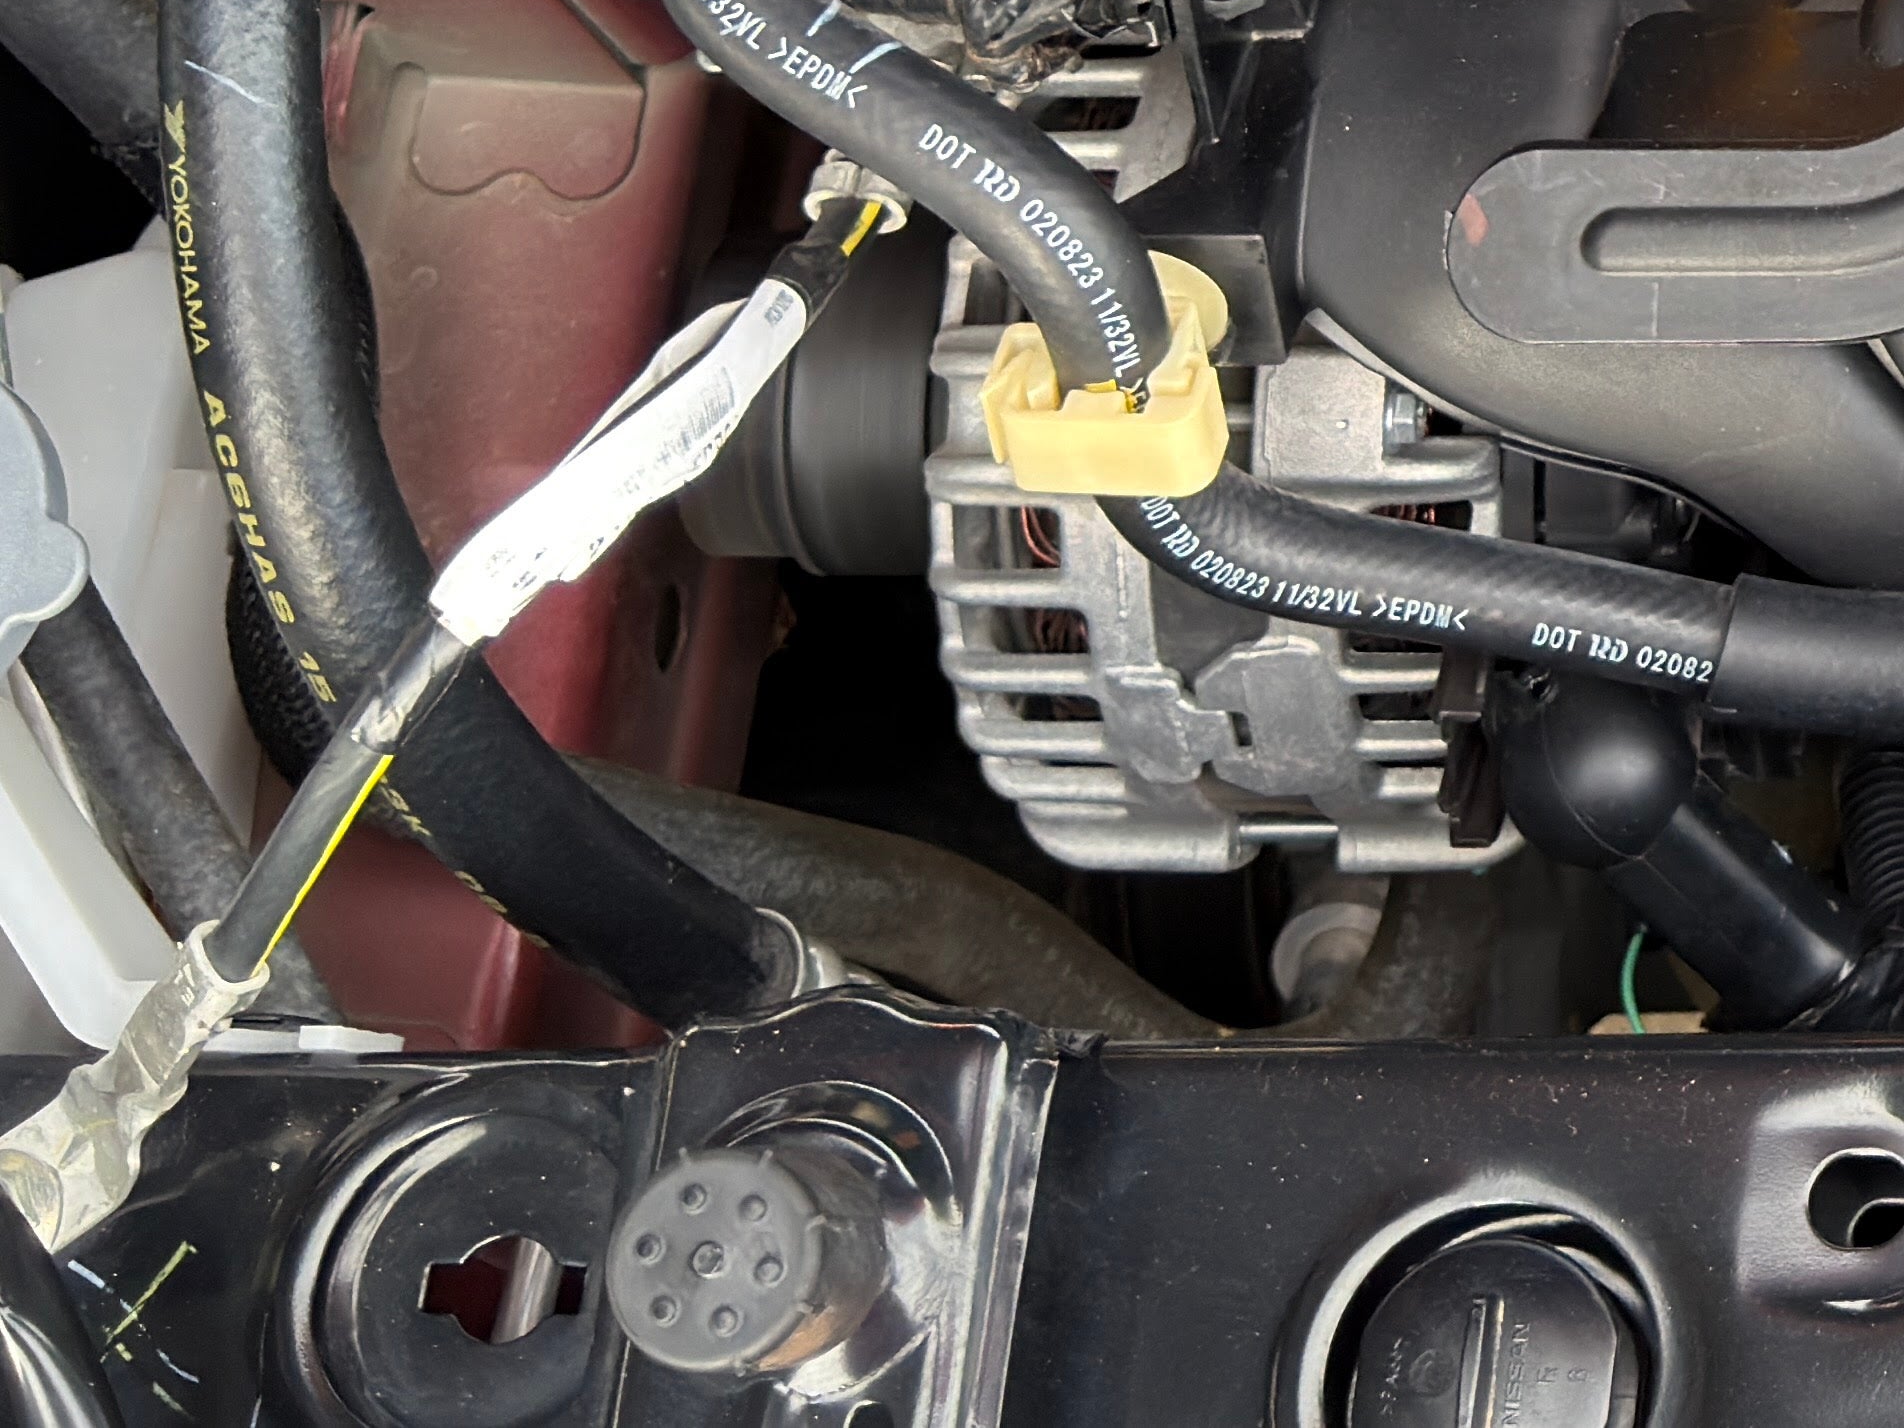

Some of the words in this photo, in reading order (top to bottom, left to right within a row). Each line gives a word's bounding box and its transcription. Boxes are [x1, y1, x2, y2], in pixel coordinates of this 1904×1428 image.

[766, 37, 872, 110] >EPDM<
[167, 153, 211, 356] YOKOHAMA
[918, 123, 976, 171] DOT
[1019, 198, 1103, 288] 020823
[1139, 495, 1181, 532] DOT
[1191, 550, 1268, 600] 020823
[1270, 578, 1363, 617] 11/32VL
[1373, 593, 1468, 632] >EPDM<
[1532, 621, 1582, 653] DOT
[1635, 644, 1714, 684] 02082
[1501, 1322, 1530, 1428] NISSAN
